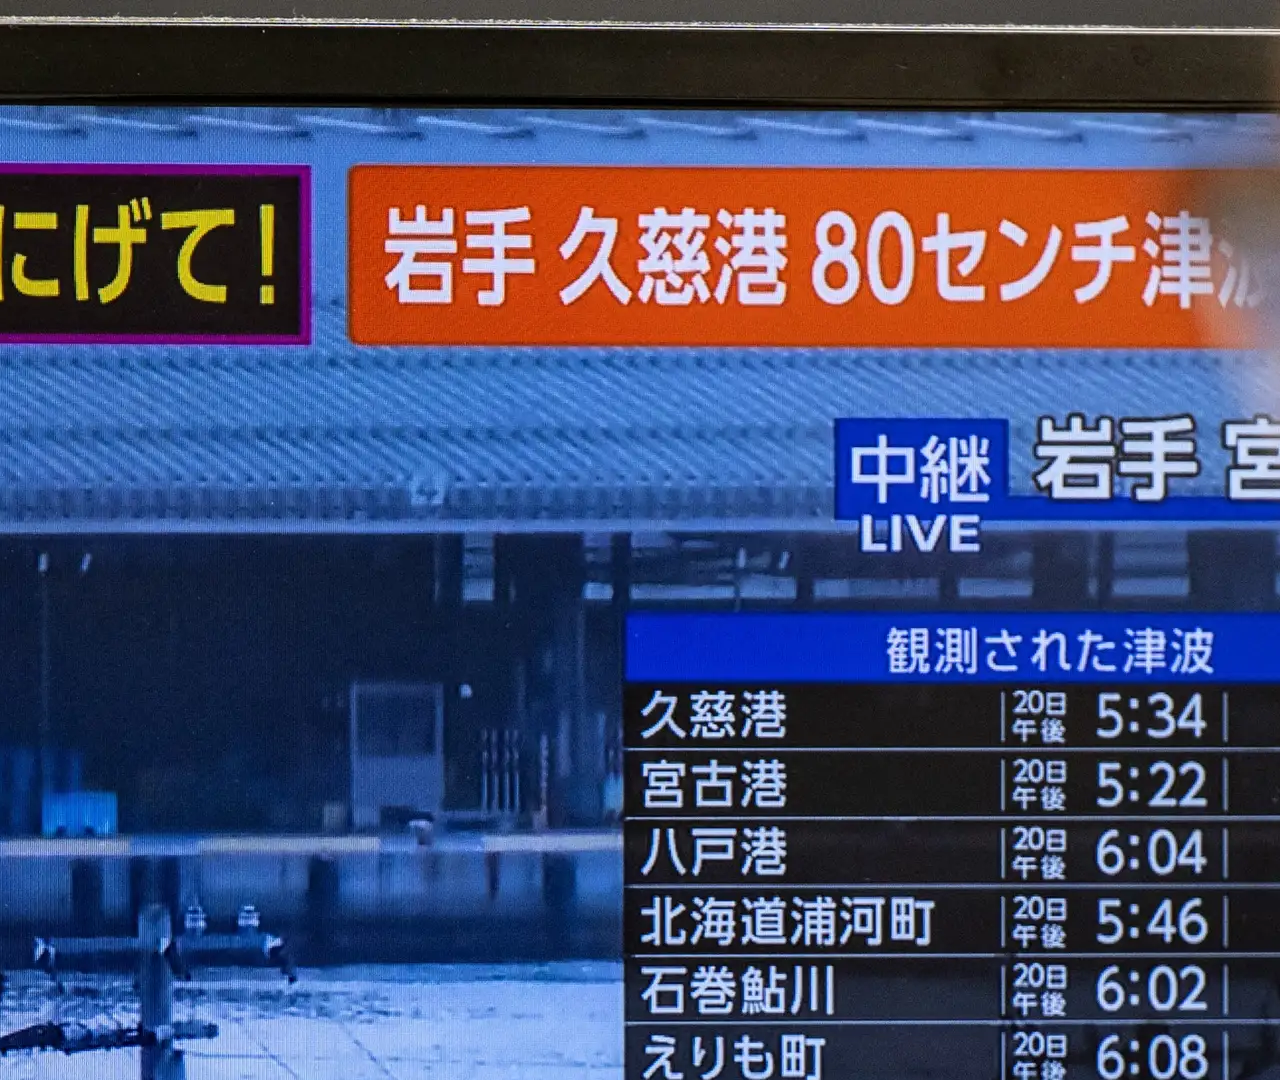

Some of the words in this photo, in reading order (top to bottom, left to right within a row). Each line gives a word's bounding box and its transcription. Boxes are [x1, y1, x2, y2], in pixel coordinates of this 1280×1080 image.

[384, 205, 534, 306] 岩手
[558, 206, 788, 306] 久慈港
[851, 434, 991, 504] 中継
[1036, 415, 1199, 501] 岩手
[859, 514, 981, 552] LIVE
[886, 626, 1215, 674] 観測された津波
[640, 690, 787, 740] 久慈港
[1012, 690, 1067, 716] 20日
[1096, 692, 1207, 740] 5:34
[1012, 718, 1067, 744] 午後
[641, 759, 787, 809] 宮古港
[1012, 758, 1067, 784] 20日
[1096, 760, 1208, 809] 5:22
[1012, 786, 1067, 811] 午後
[641, 826, 787, 876] 八戸港
[1012, 826, 1067, 852] 20日
[1096, 828, 1208, 875] 6:04
[1012, 855, 1067, 880] 午後
[640, 896, 935, 946] 北海道浦河町
[1012, 896, 1067, 921] 20日
[1096, 897, 1208, 945] 5:46
[1012, 924, 1067, 949] 午後
[640, 965, 835, 1016] 石巻鮎川
[1012, 963, 1067, 989] 20日
[1096, 965, 1208, 1012] 6:02
[1012, 991, 1067, 1017] 午後
[1012, 1031, 1067, 1057] 20日
